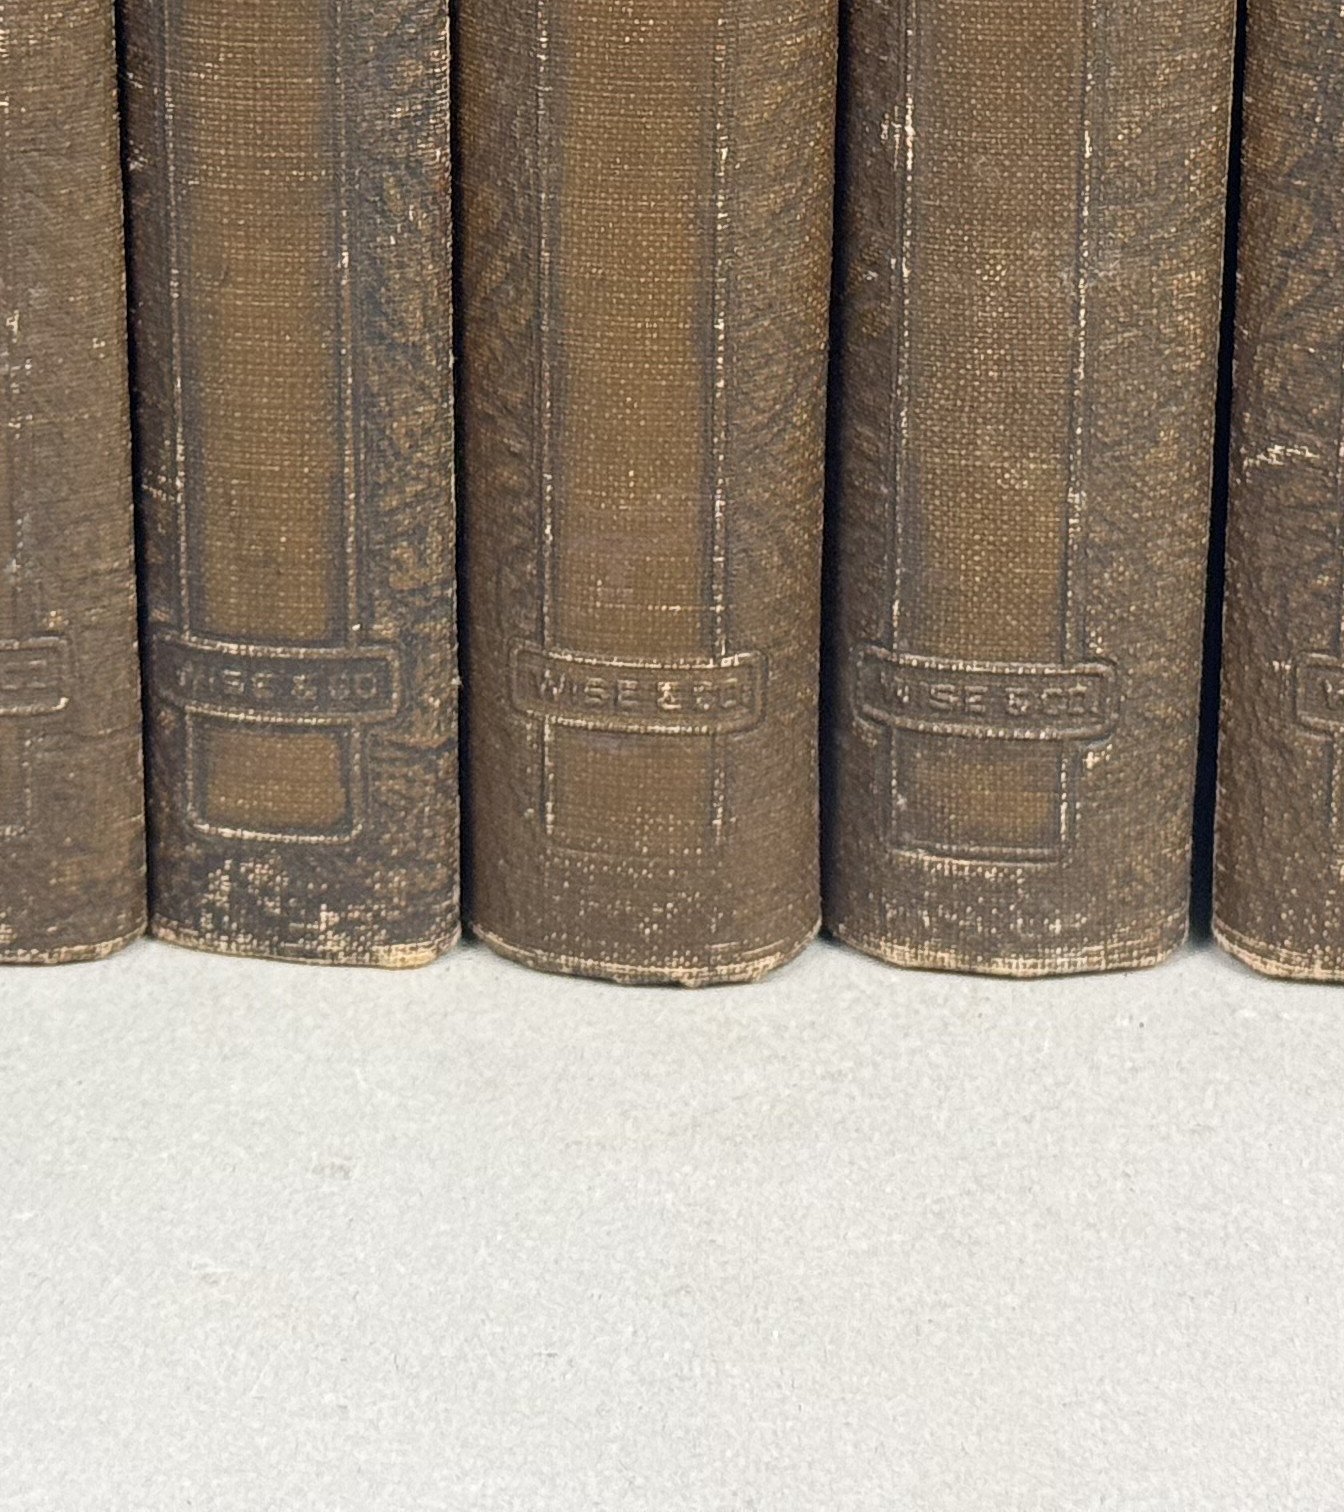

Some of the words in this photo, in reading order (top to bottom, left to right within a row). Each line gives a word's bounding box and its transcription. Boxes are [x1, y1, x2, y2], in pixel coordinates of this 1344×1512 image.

[538, 667, 639, 709] WISE
[655, 679, 684, 711] &
[879, 670, 987, 714] WISE
